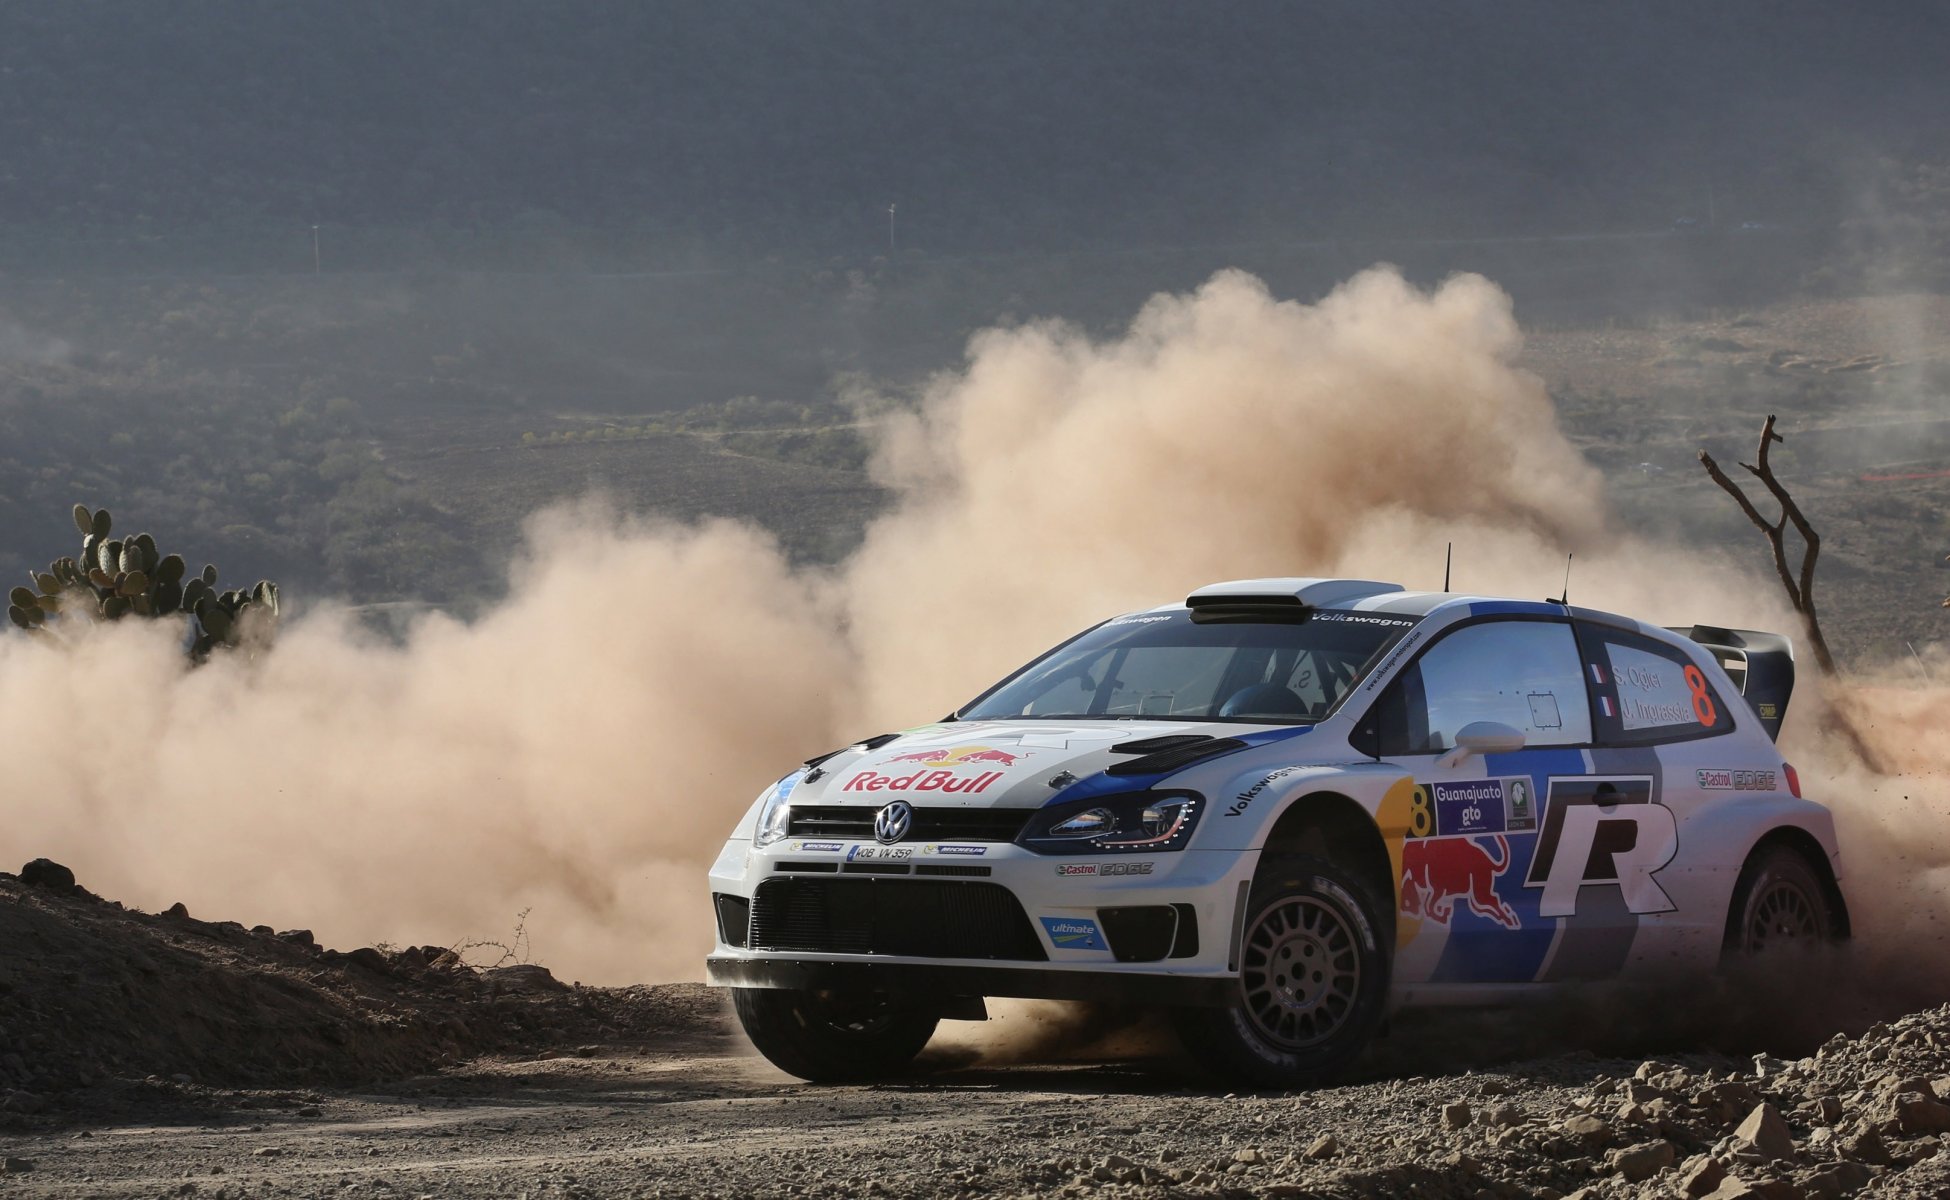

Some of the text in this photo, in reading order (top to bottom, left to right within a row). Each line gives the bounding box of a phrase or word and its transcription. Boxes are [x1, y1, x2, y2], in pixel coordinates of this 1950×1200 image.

[1311, 612, 1414, 627] Volkswagen
[1627, 667, 1663, 692] Ogier
[1683, 664, 1716, 727] 8
[1635, 699, 1691, 725] Ingrassia
[1705, 770, 1777, 790] Castrol EDGE
[1436, 784, 1502, 805] Guanajuato
[1410, 783, 1431, 838] 8
[1462, 806, 1481, 826] gto
[805, 843, 842, 851] MICHELIN
[855, 848, 875, 858] WOB
[941, 847, 985, 855] MICHELIN
[1066, 861, 1154, 876] Castrol EDGE
[1539, 802, 1679, 917] R
[1052, 923, 1095, 934] ultimate
